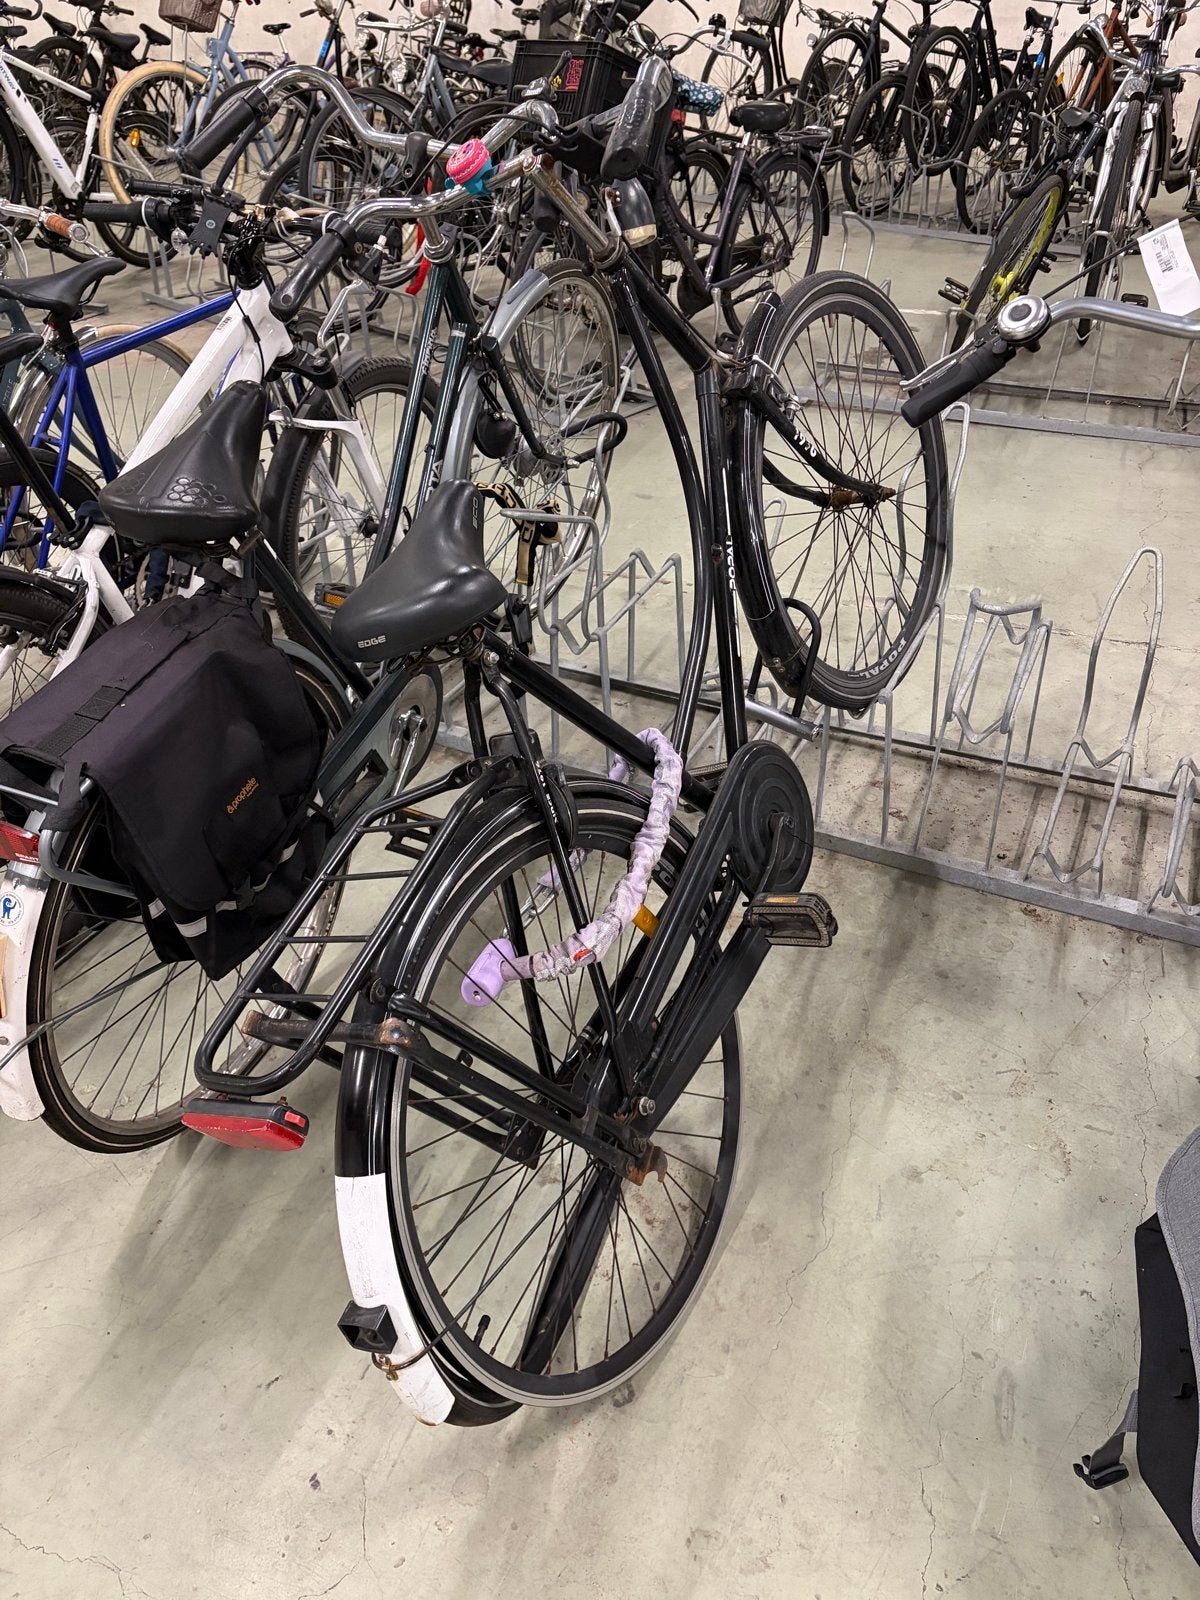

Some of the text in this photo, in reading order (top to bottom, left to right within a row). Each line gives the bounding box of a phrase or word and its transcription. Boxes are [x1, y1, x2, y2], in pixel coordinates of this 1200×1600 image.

[725, 535, 738, 590] POPAL
[357, 634, 387, 649] EDGE
[859, 637, 907, 679] POPAL
